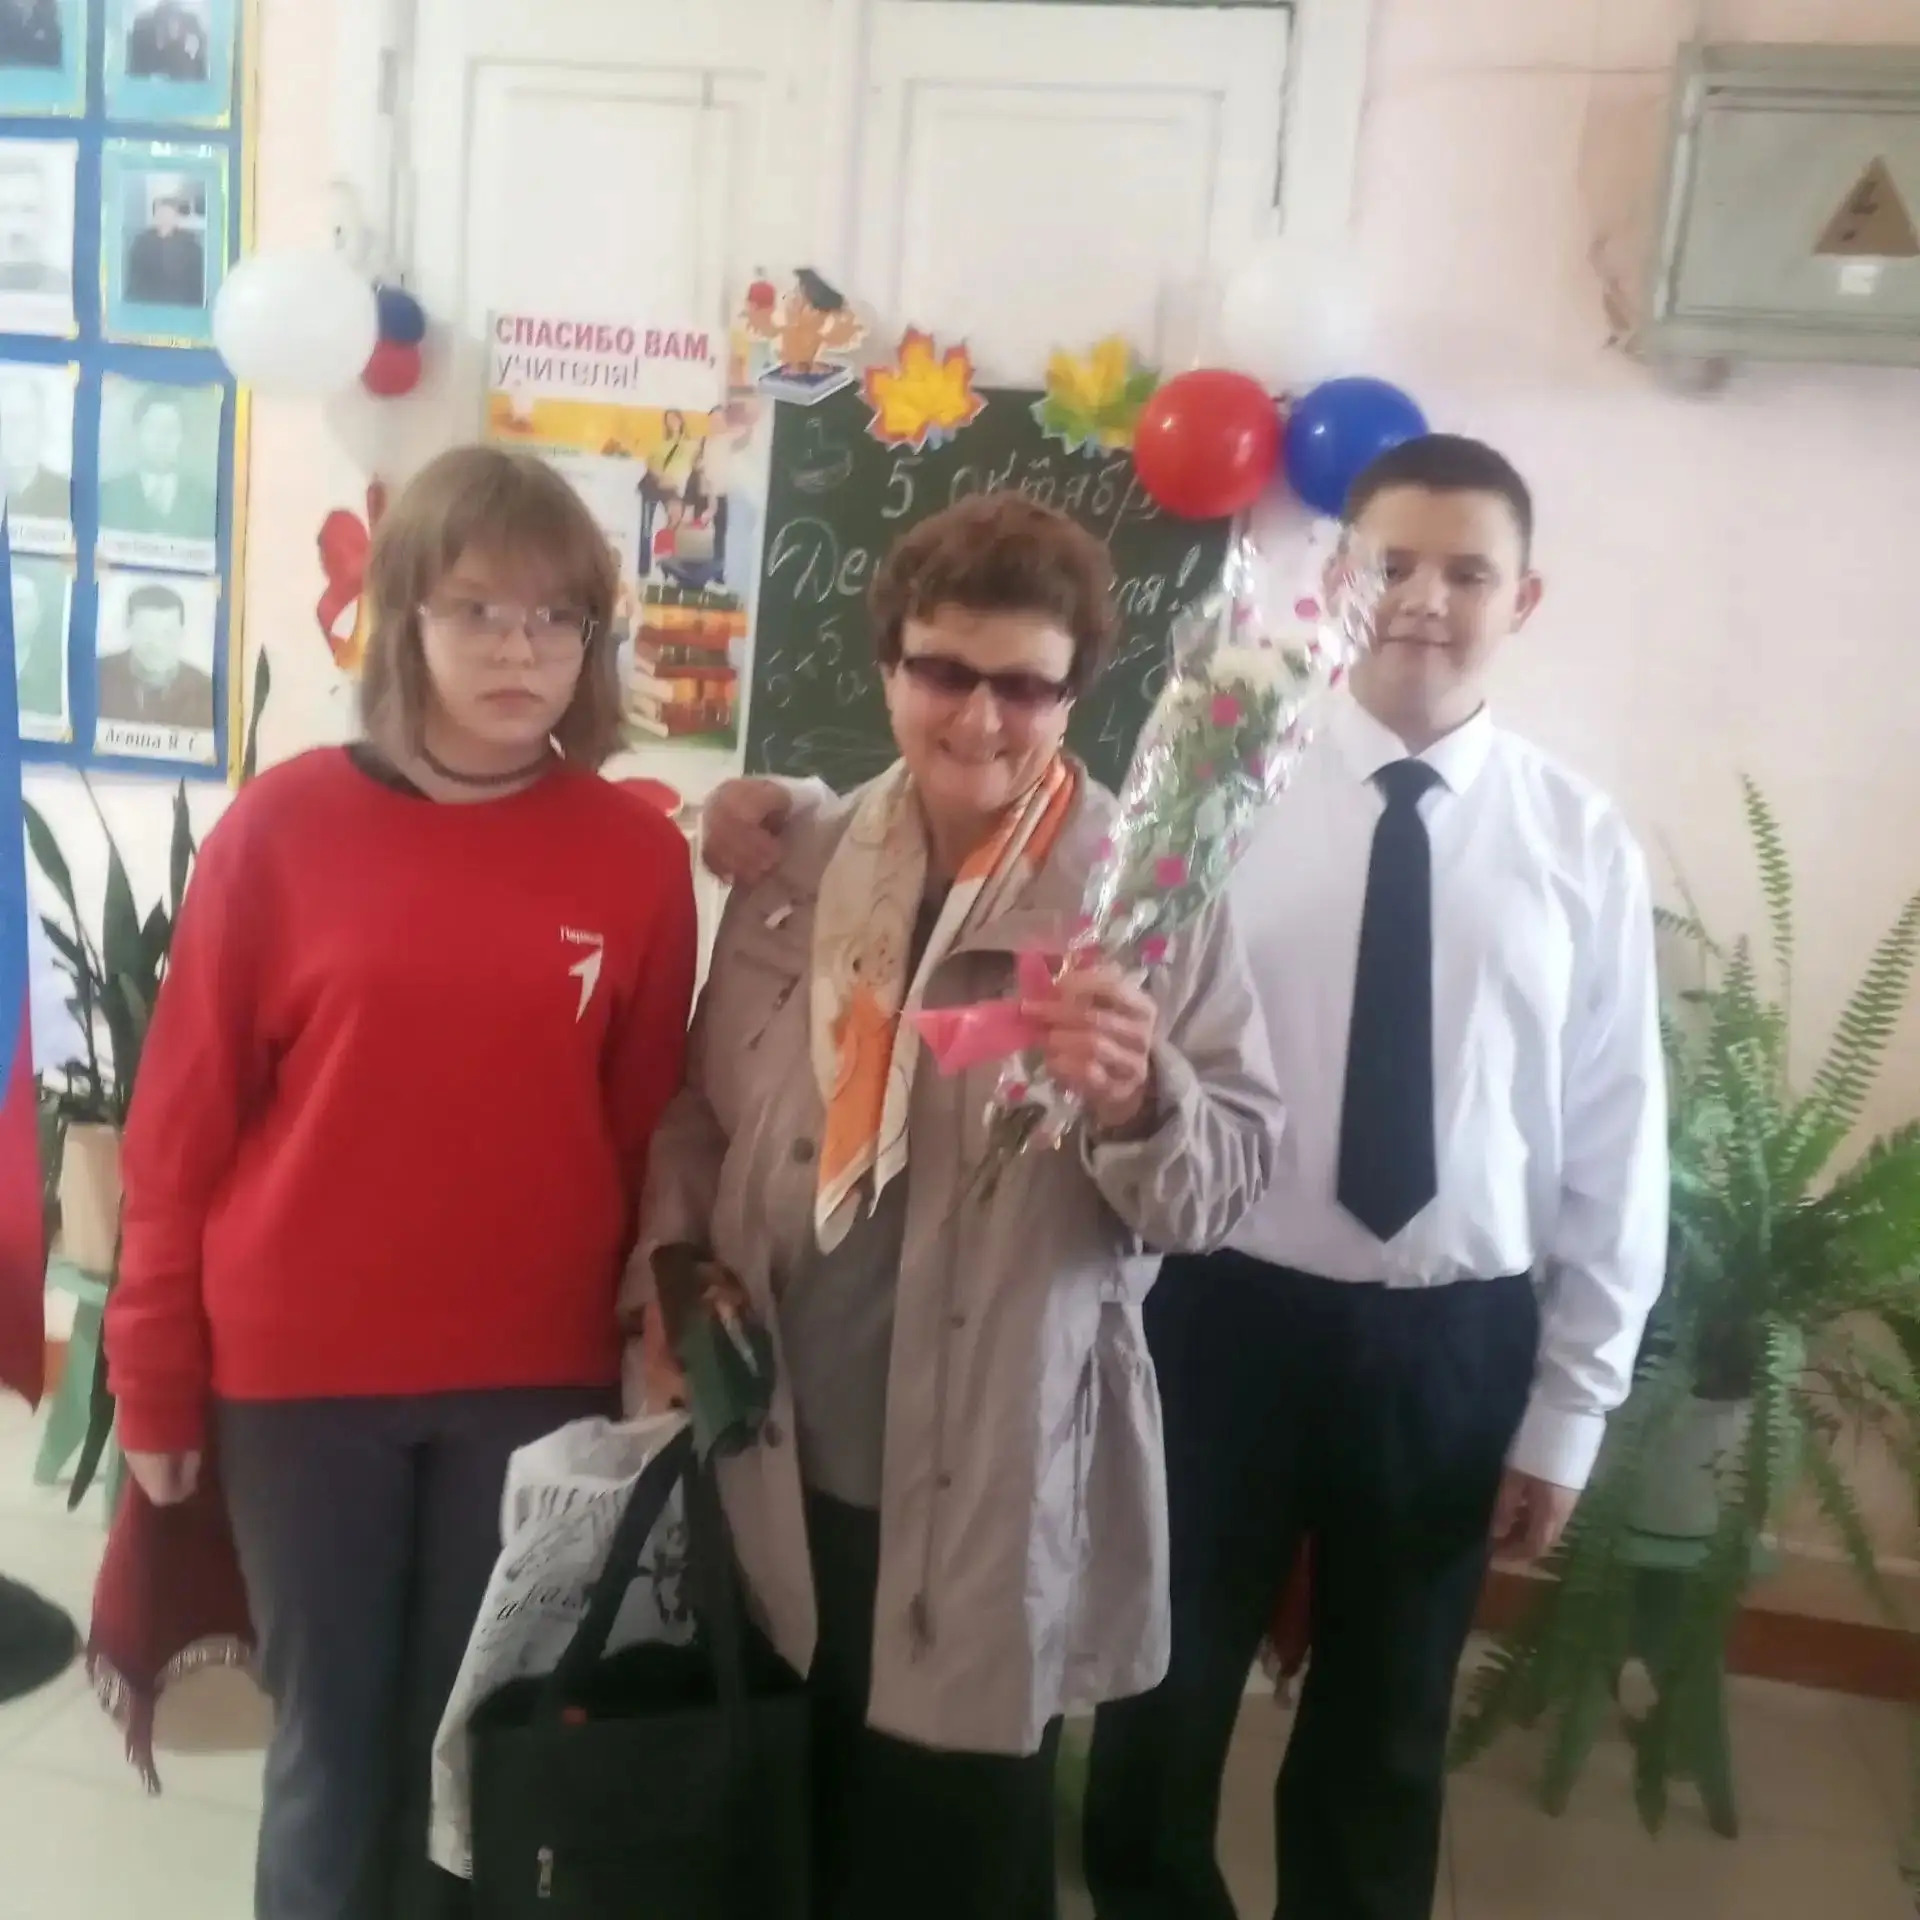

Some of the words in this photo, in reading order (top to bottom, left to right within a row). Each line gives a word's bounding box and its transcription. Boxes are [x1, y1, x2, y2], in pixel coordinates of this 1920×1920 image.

[495, 316, 635, 356] СПАСИБО
[643, 328, 716, 368] ВАМ,
[881, 457, 923, 519] 5
